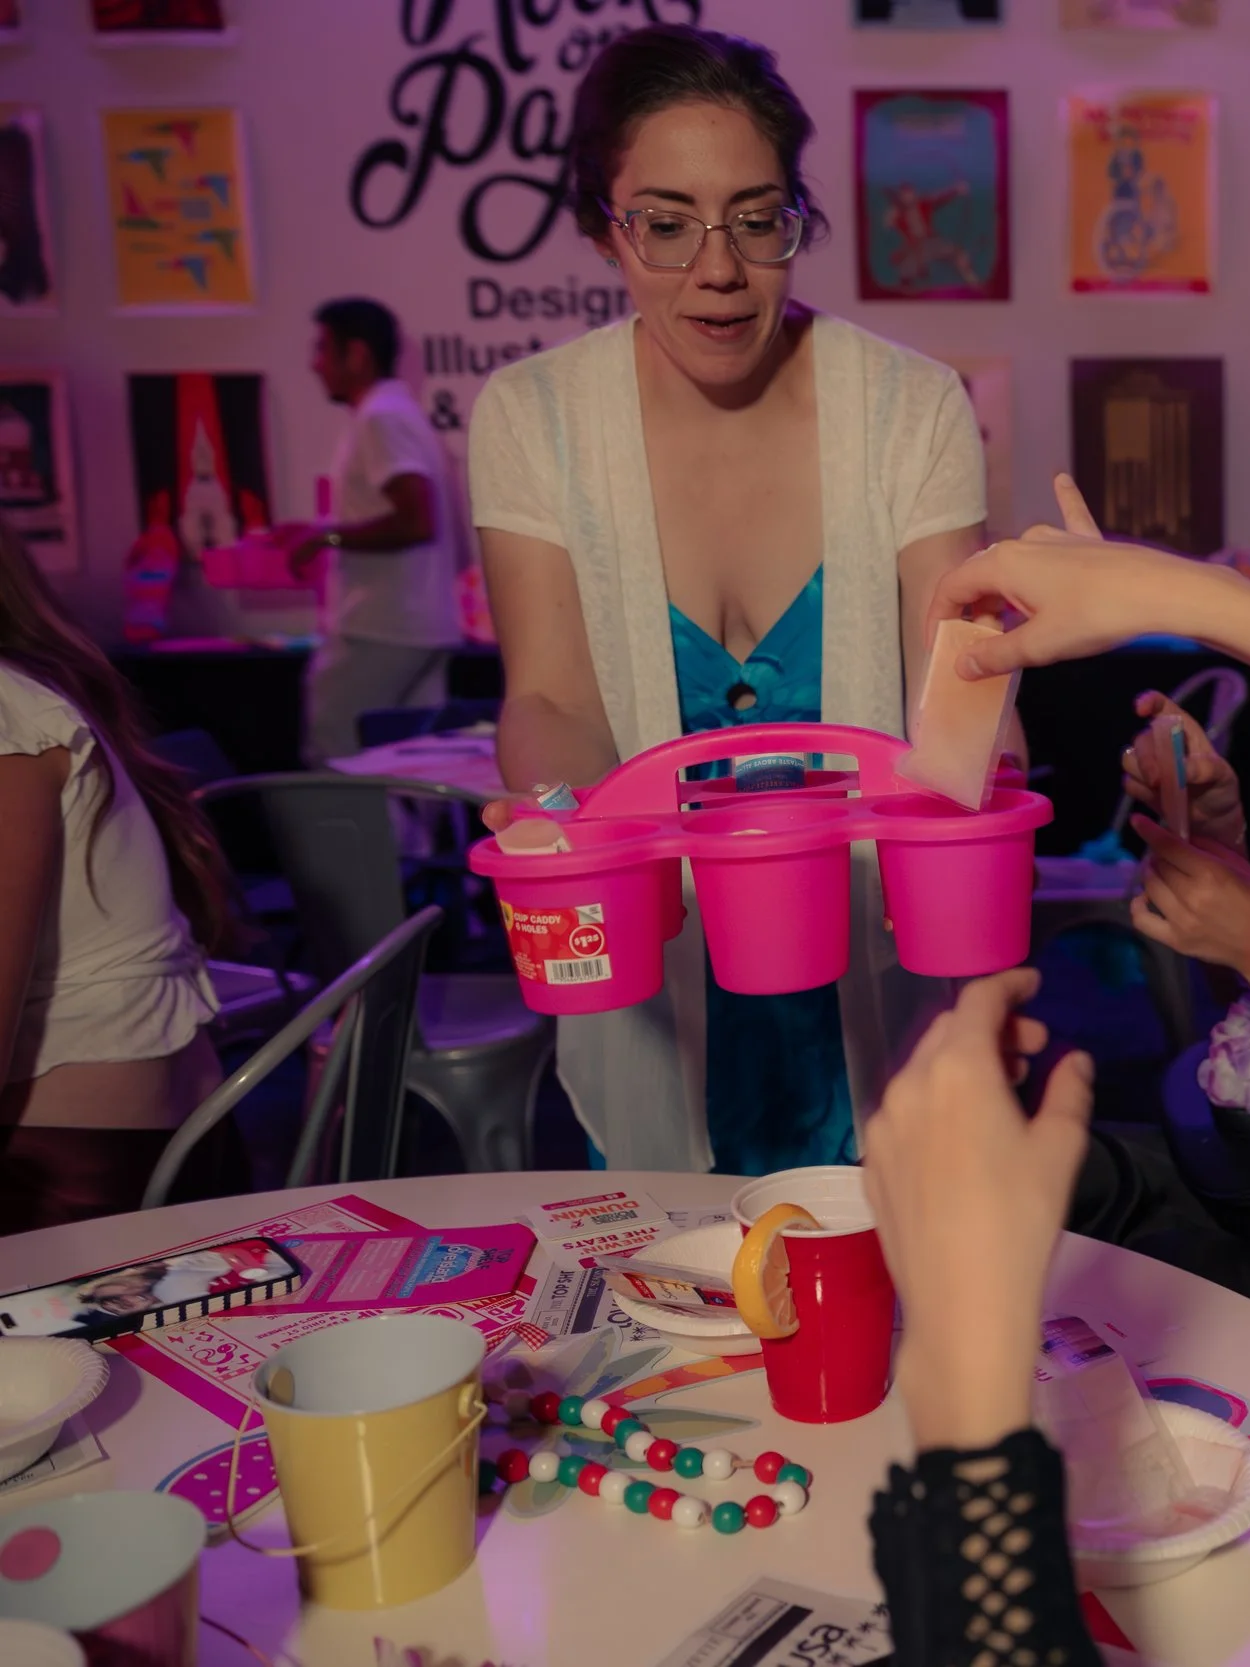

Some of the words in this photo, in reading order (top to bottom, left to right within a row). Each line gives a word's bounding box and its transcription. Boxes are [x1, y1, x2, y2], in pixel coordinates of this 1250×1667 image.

[430, 388, 461, 430] &
[513, 912, 529, 922] CUP
[530, 914, 561, 925] CADDY
[522, 923, 549, 935] HOLES
[548, 1200, 640, 1222] DUNKIN'
[621, 1227, 660, 1238] THE
[562, 1233, 620, 1250] BEATS
[579, 1234, 656, 1256] BREWIN'
[551, 1282, 570, 1300] TOP
